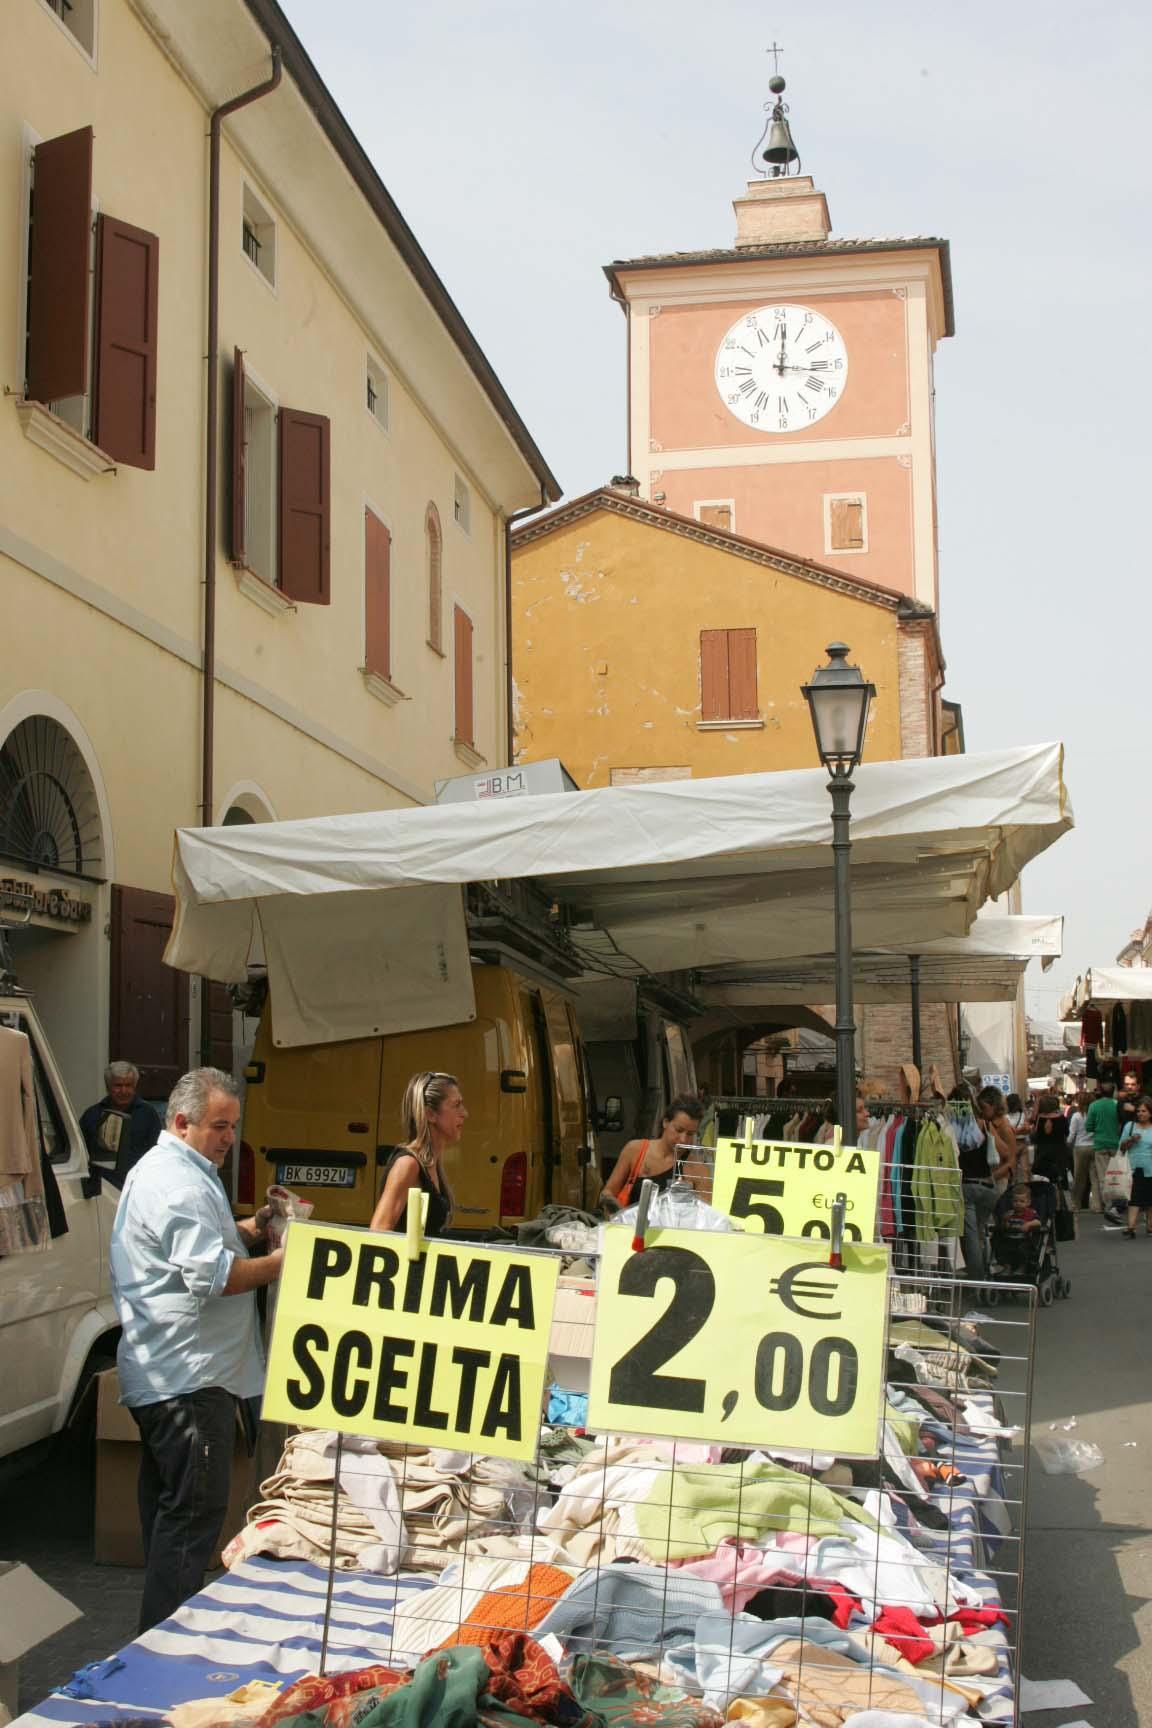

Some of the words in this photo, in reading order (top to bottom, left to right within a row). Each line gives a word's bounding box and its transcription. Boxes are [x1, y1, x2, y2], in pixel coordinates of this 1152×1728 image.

[286, 1167, 302, 1181] BK
[730, 1142, 834, 1171] TUTTO
[845, 1152, 866, 1174] A
[812, 1193, 855, 1211] €uo
[307, 1236, 536, 1330] PRIMA
[286, 1323, 523, 1441] SCELTA
